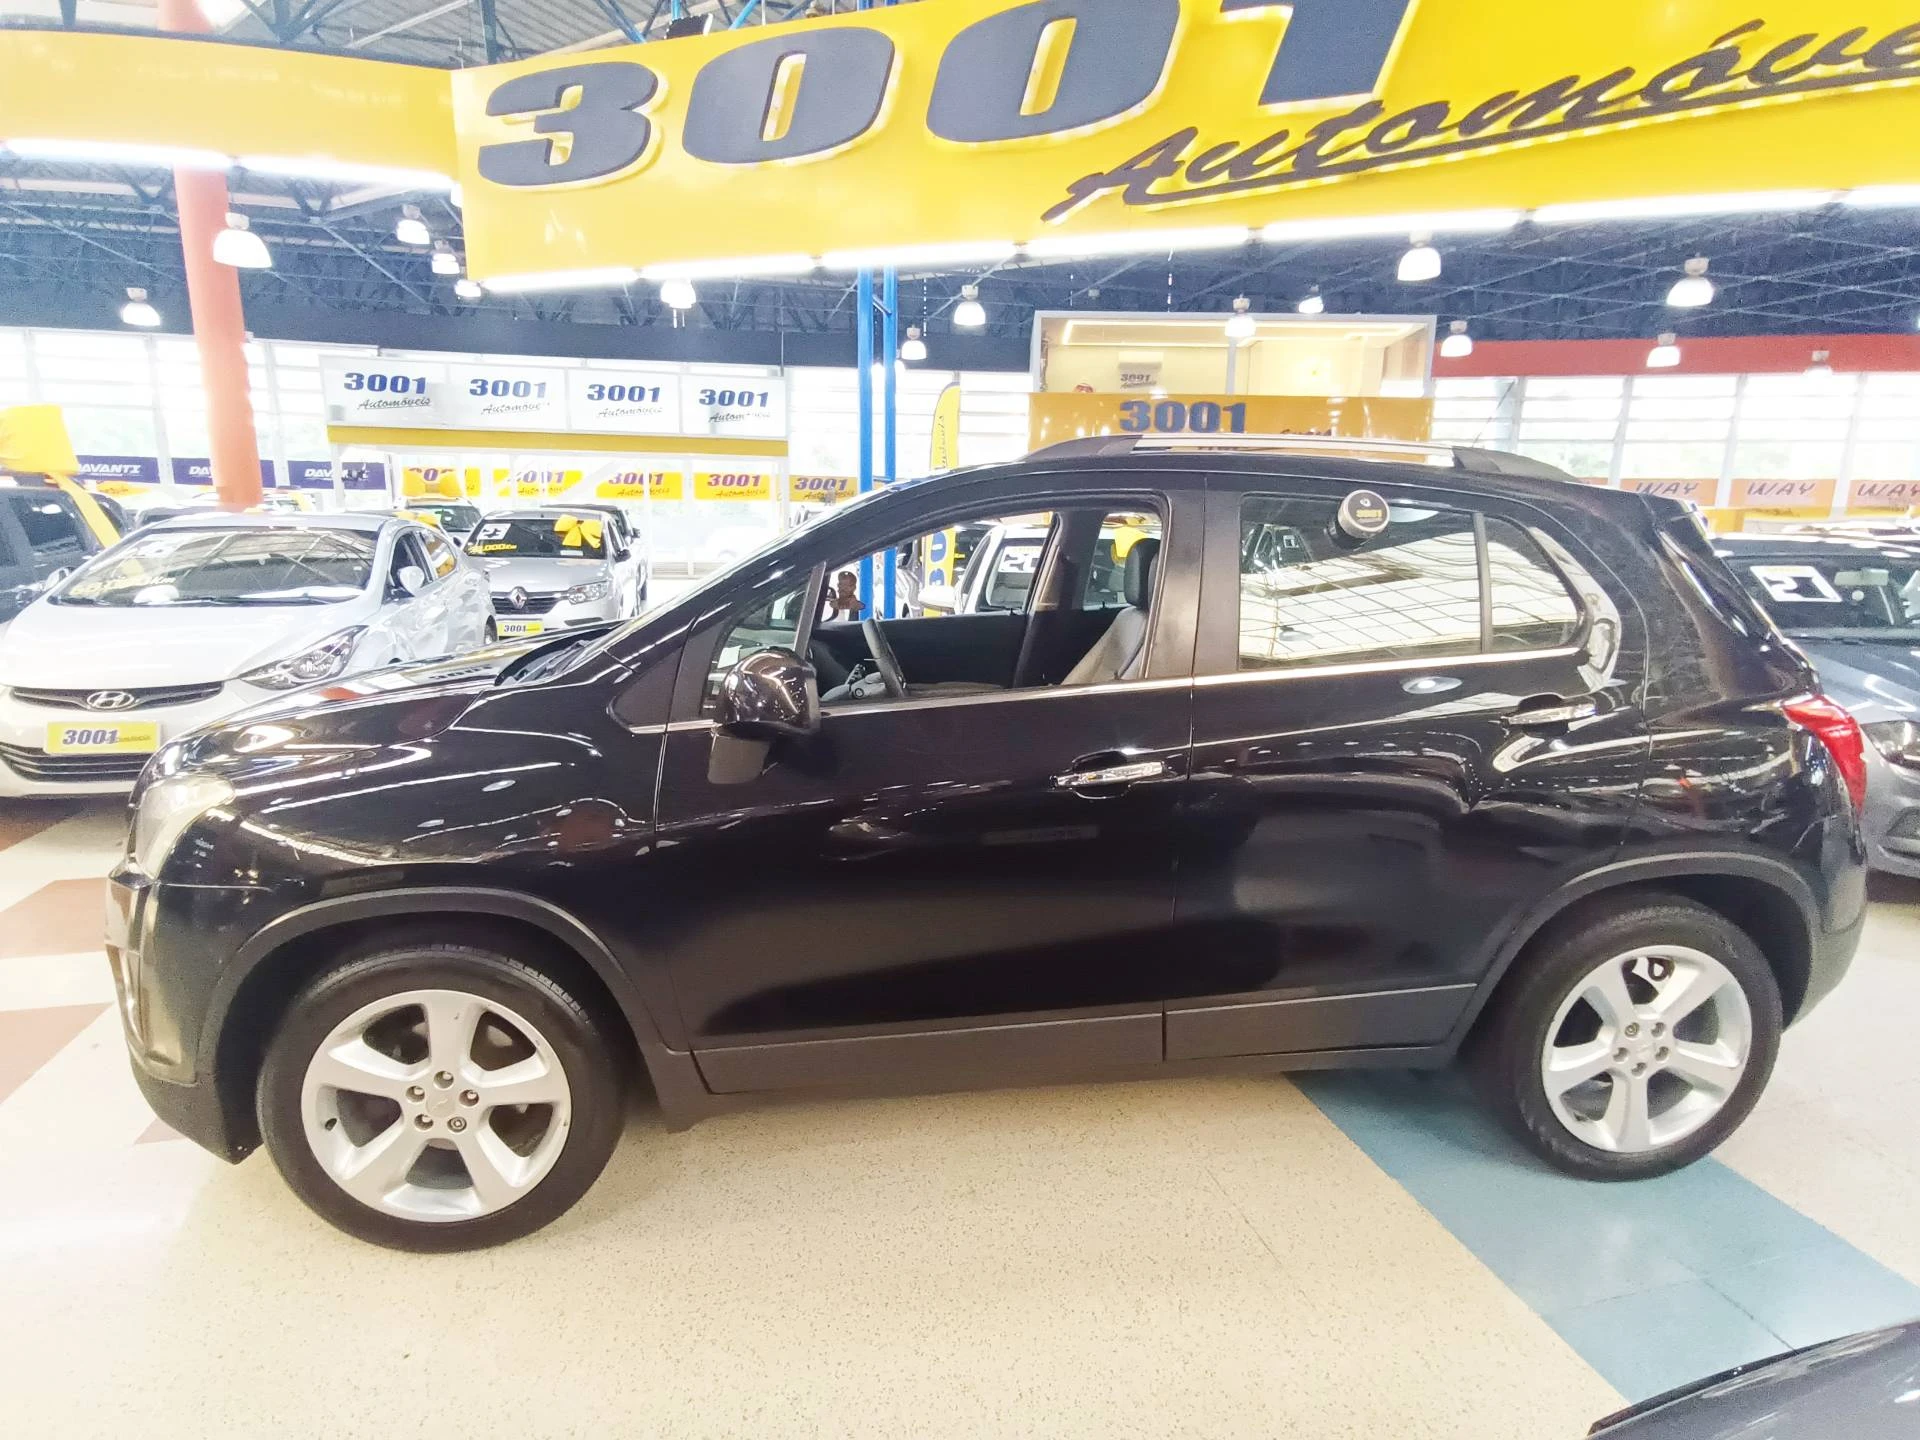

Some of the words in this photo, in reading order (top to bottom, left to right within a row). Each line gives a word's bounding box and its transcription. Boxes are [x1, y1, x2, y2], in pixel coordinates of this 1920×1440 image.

[477, 0, 1411, 187] 3001
[344, 372, 427, 395] 3001
[469, 378, 547, 399] 3001
[587, 383, 660, 403] 3001
[698, 388, 769, 408] 3001
[1119, 399, 1247, 434] 3001
[80, 463, 141, 474] AVANTI
[707, 473, 761, 487] 3001
[794, 477, 849, 491] 3001
[1747, 482, 1816, 496] WAY
[503, 624, 527, 633] 3001
[62, 728, 119, 745] 3001
